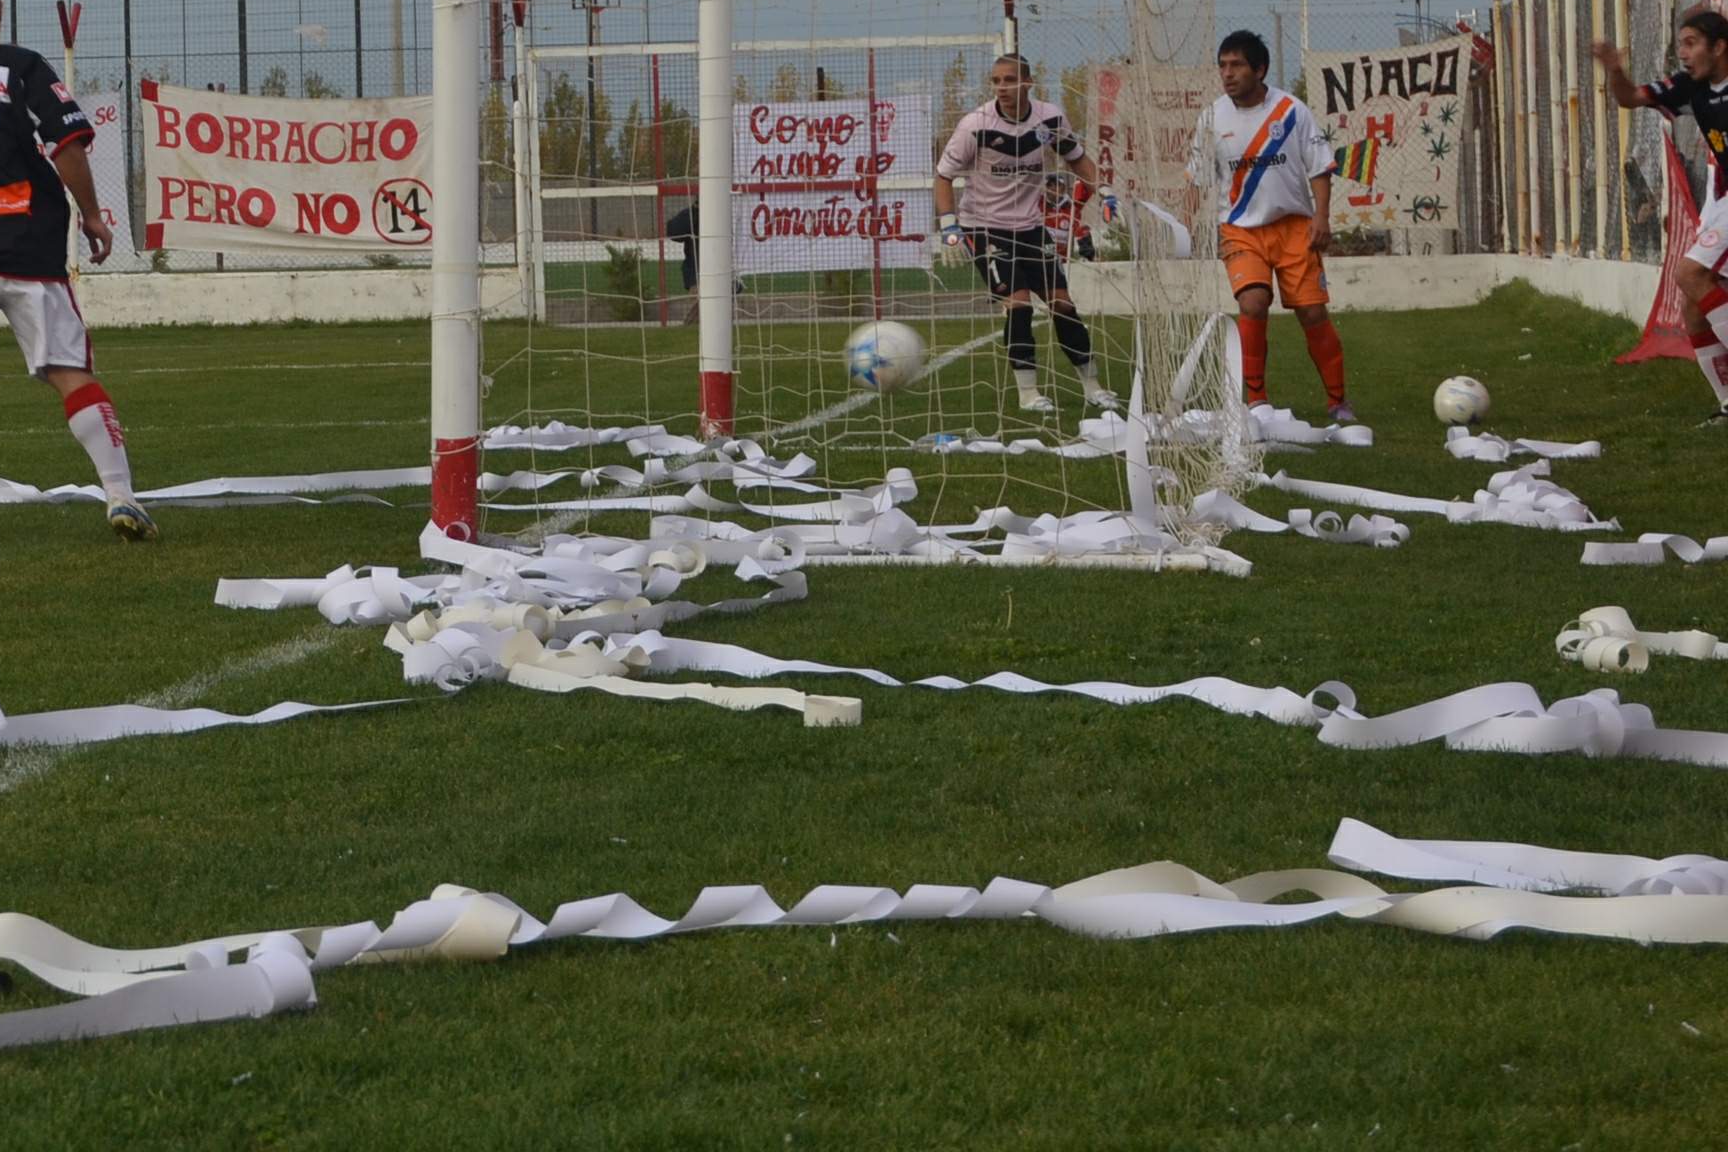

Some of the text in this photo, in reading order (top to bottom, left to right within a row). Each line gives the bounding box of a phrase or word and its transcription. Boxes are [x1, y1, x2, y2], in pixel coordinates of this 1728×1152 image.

[95, 104, 118, 126] se
[153, 104, 418, 165] BORRACHO
[750, 105, 864, 145] Como
[157, 177, 428, 235] PERO NO 14
